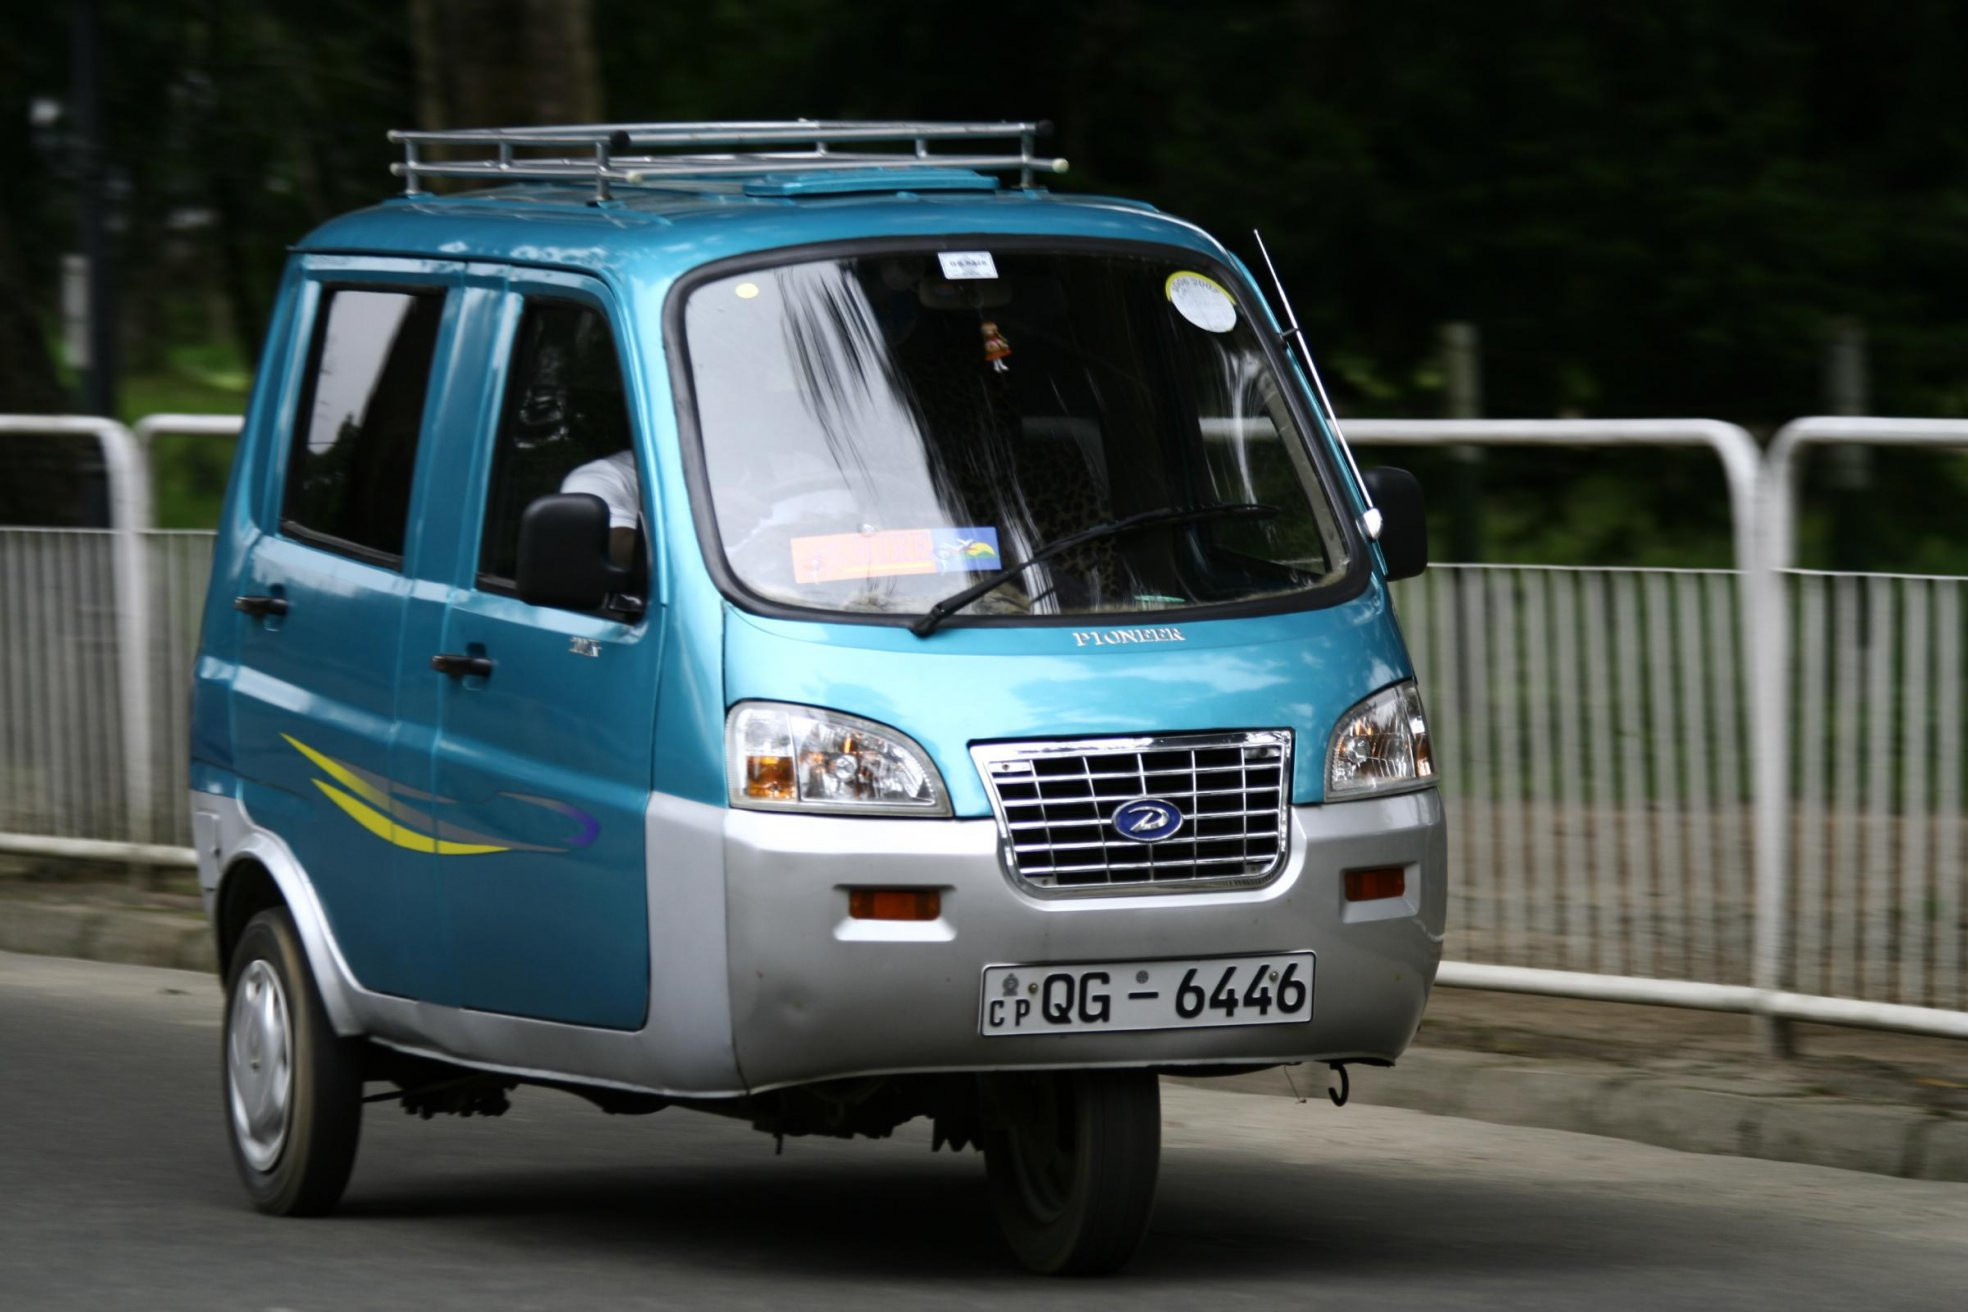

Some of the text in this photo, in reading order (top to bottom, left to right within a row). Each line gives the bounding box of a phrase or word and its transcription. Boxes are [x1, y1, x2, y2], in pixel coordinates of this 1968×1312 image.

[1073, 628, 1187, 646] PIONEER
[1042, 971, 1111, 1025] QG
[1176, 962, 1307, 1020] 6446
